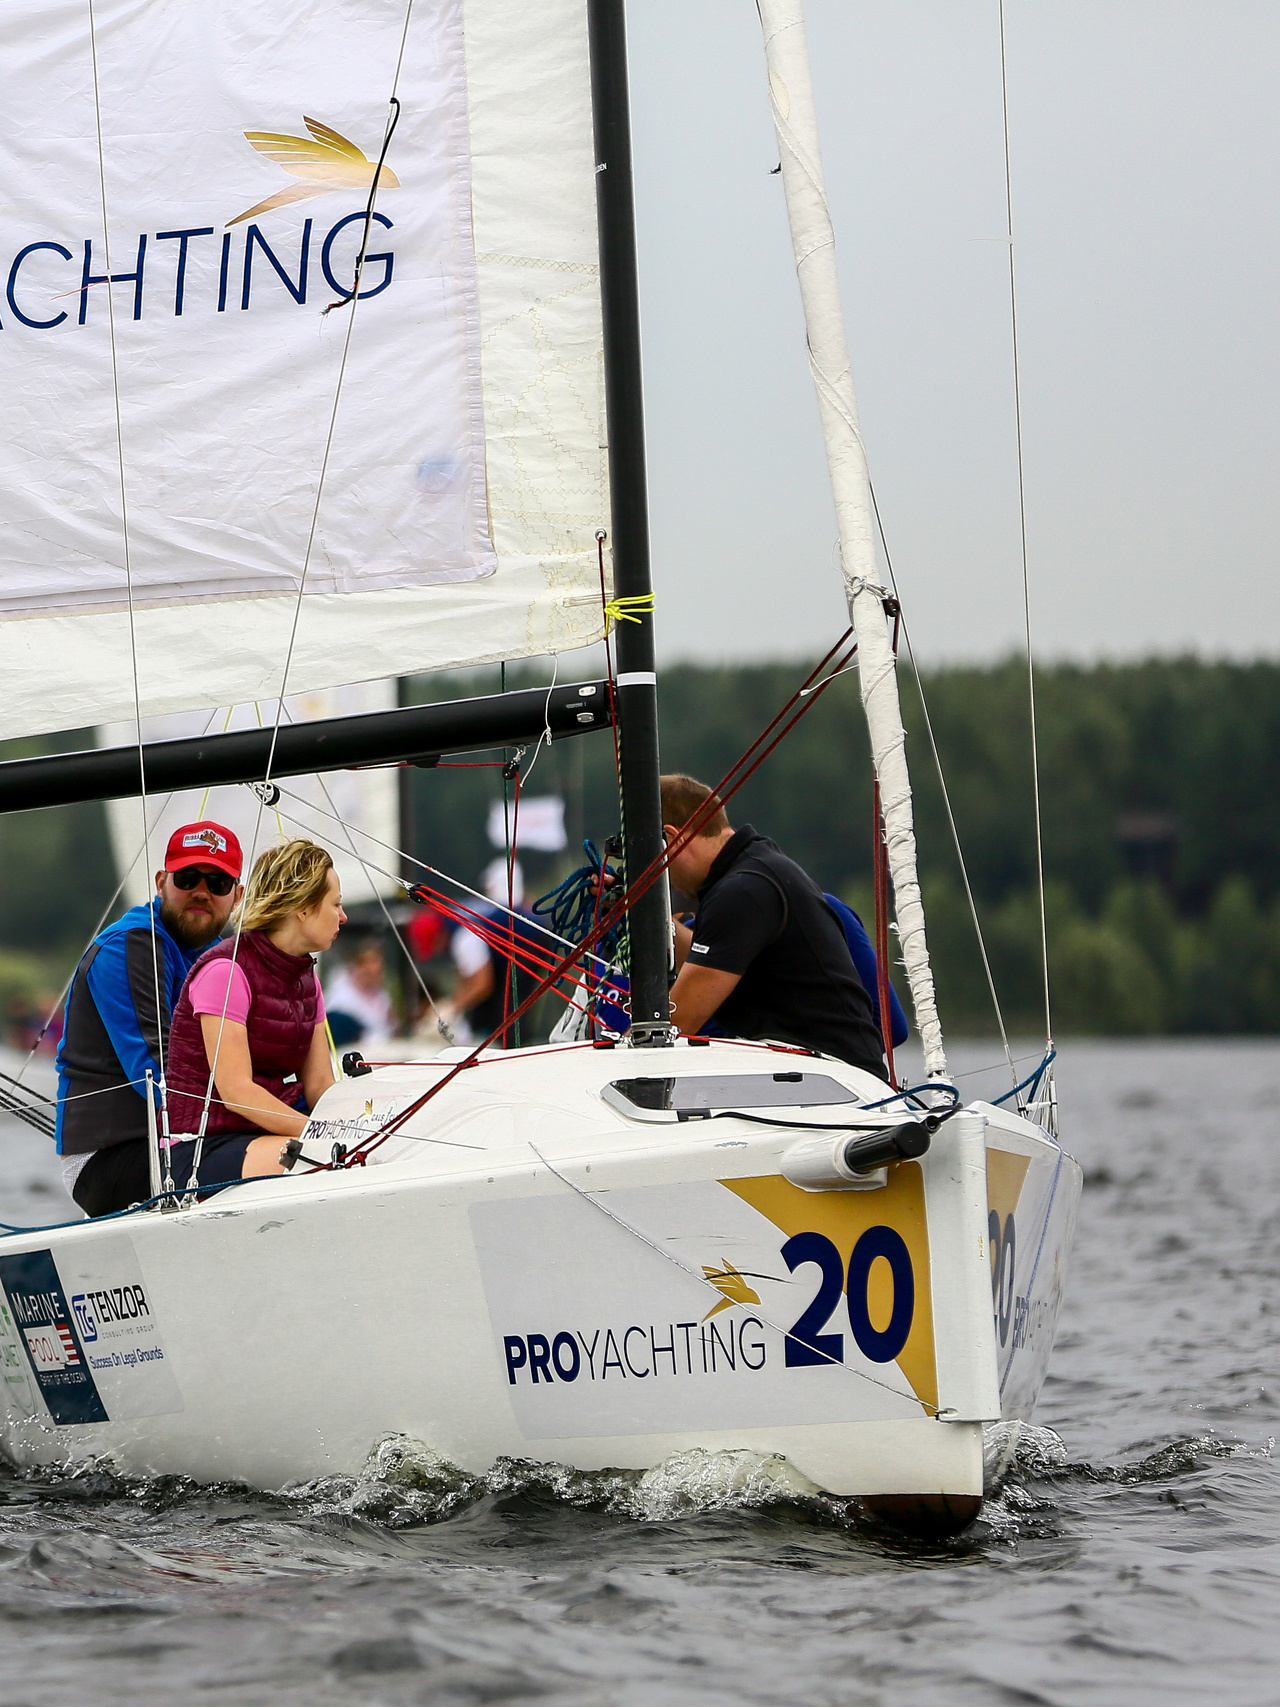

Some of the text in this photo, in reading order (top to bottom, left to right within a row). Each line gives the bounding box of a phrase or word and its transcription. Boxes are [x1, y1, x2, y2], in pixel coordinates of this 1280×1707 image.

[10, 1292, 65, 1323] MARINE
[86, 1285, 150, 1324] TENZOR
[780, 1225, 915, 1368] 20
[28, 1337, 60, 1363] POOL
[136, 1345, 164, 1363] Grounds
[503, 1317, 766, 1385] PROYACHTING
